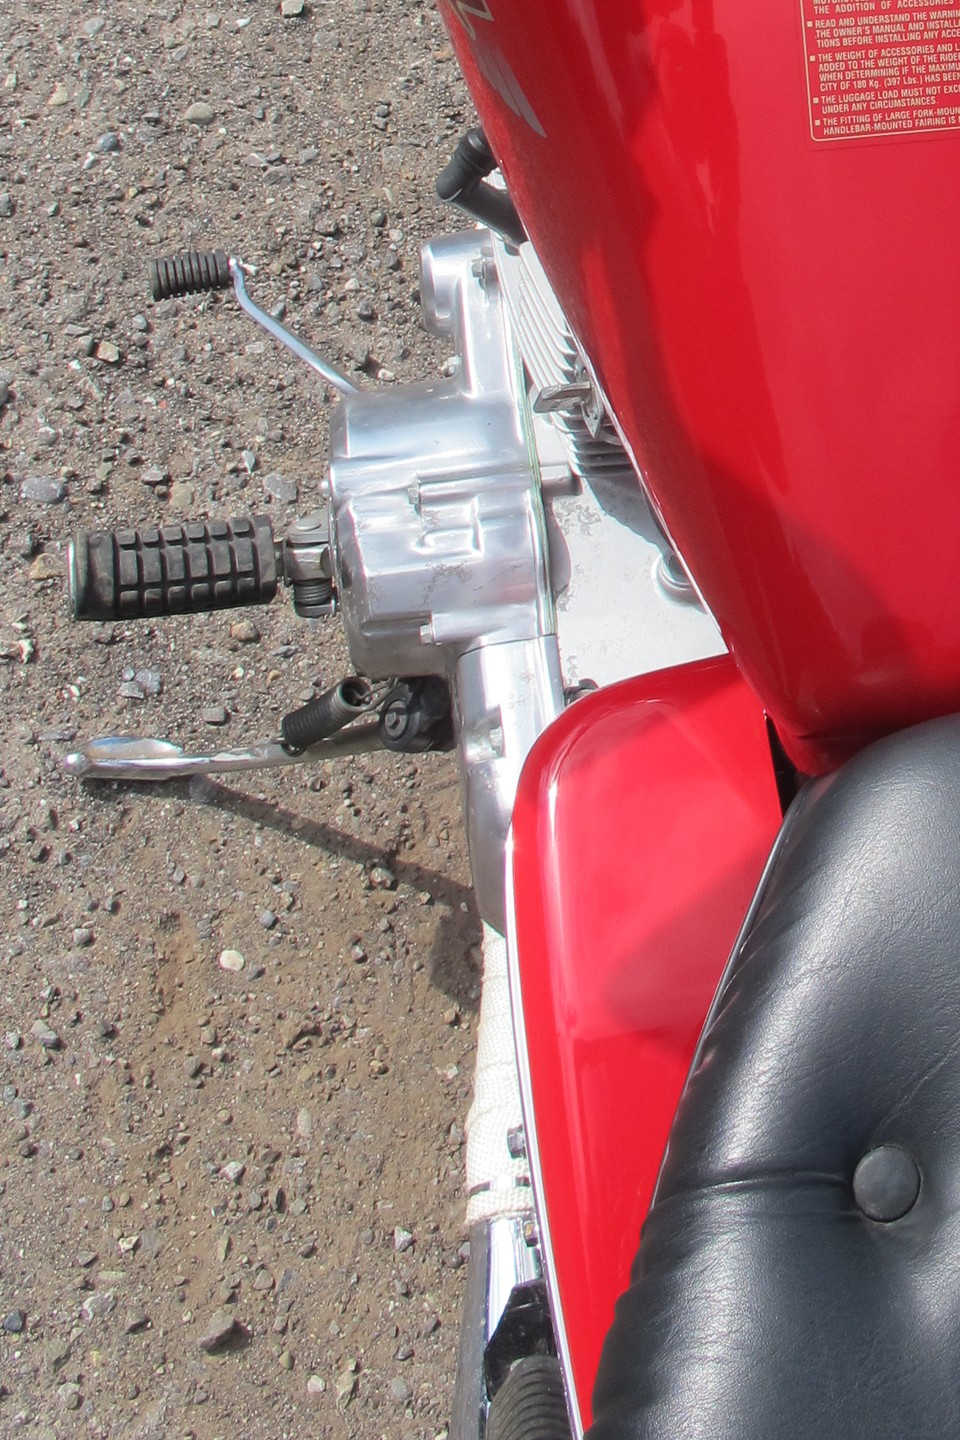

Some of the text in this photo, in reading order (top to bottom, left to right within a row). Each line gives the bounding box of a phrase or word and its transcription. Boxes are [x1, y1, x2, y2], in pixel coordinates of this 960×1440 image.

[813, 4, 829, 14] THE
[834, 1, 875, 13] ADDITION
[880, 0, 891, 9] OF
[814, 18, 836, 28] READ
[838, 17, 855, 26] AND
[857, 12, 910, 25] UNDERSTAND
[912, 11, 926, 20] THE
[815, 28, 830, 38] THE
[833, 25, 870, 37] OWNER'S
[872, 23, 905, 33] MANUAL
[908, 22, 924, 31] AND
[816, 37, 840, 48] TIONS
[842, 35, 872, 46] BEFORE
[875, 31, 921, 43] INSTALLING
[922, 30, 938, 39] ANY
[817, 52, 832, 62] THE
[834, 50, 865, 60] WEIGHT
[867, 48, 878, 58] OF
[880, 44, 934, 57] ACCESSORIES
[936, 43, 952, 52] AND
[818, 61, 845, 72] ADDED
[848, 60, 858, 69] TO
[860, 59, 874, 68] THE
[877, 56, 907, 66] WEIGHT
[910, 55, 920, 64] OF
[923, 54, 936, 63] THE
[818, 71, 842, 81] WHEN
[845, 66, 899, 79] DETERMINING
[901, 66, 909, 74] IF
[911, 64, 926, 74] THE
[819, 81, 837, 92] CITY
[839, 80, 850, 90] OF
[883, 76, 900, 87] (397
[924, 73, 940, 82] HAS
[820, 94, 835, 104] THE
[838, 91, 875, 102] LUGGAGE
[877, 89, 898, 99] LOAD
[900, 87, 923, 97] MUST
[925, 85, 941, 95] NOT
[821, 103, 849, 114] UNDER
[851, 102, 866, 111] ANY
[822, 116, 837, 126] THE
[840, 114, 870, 124] FITTING
[872, 112, 882, 121] OF
[885, 110, 910, 120] LARGE
[823, 119, 912, 135] HANDLEBAR-MOUNTED
[914, 116, 946, 127] FAIRING
[948, 115, 956, 124] IS
